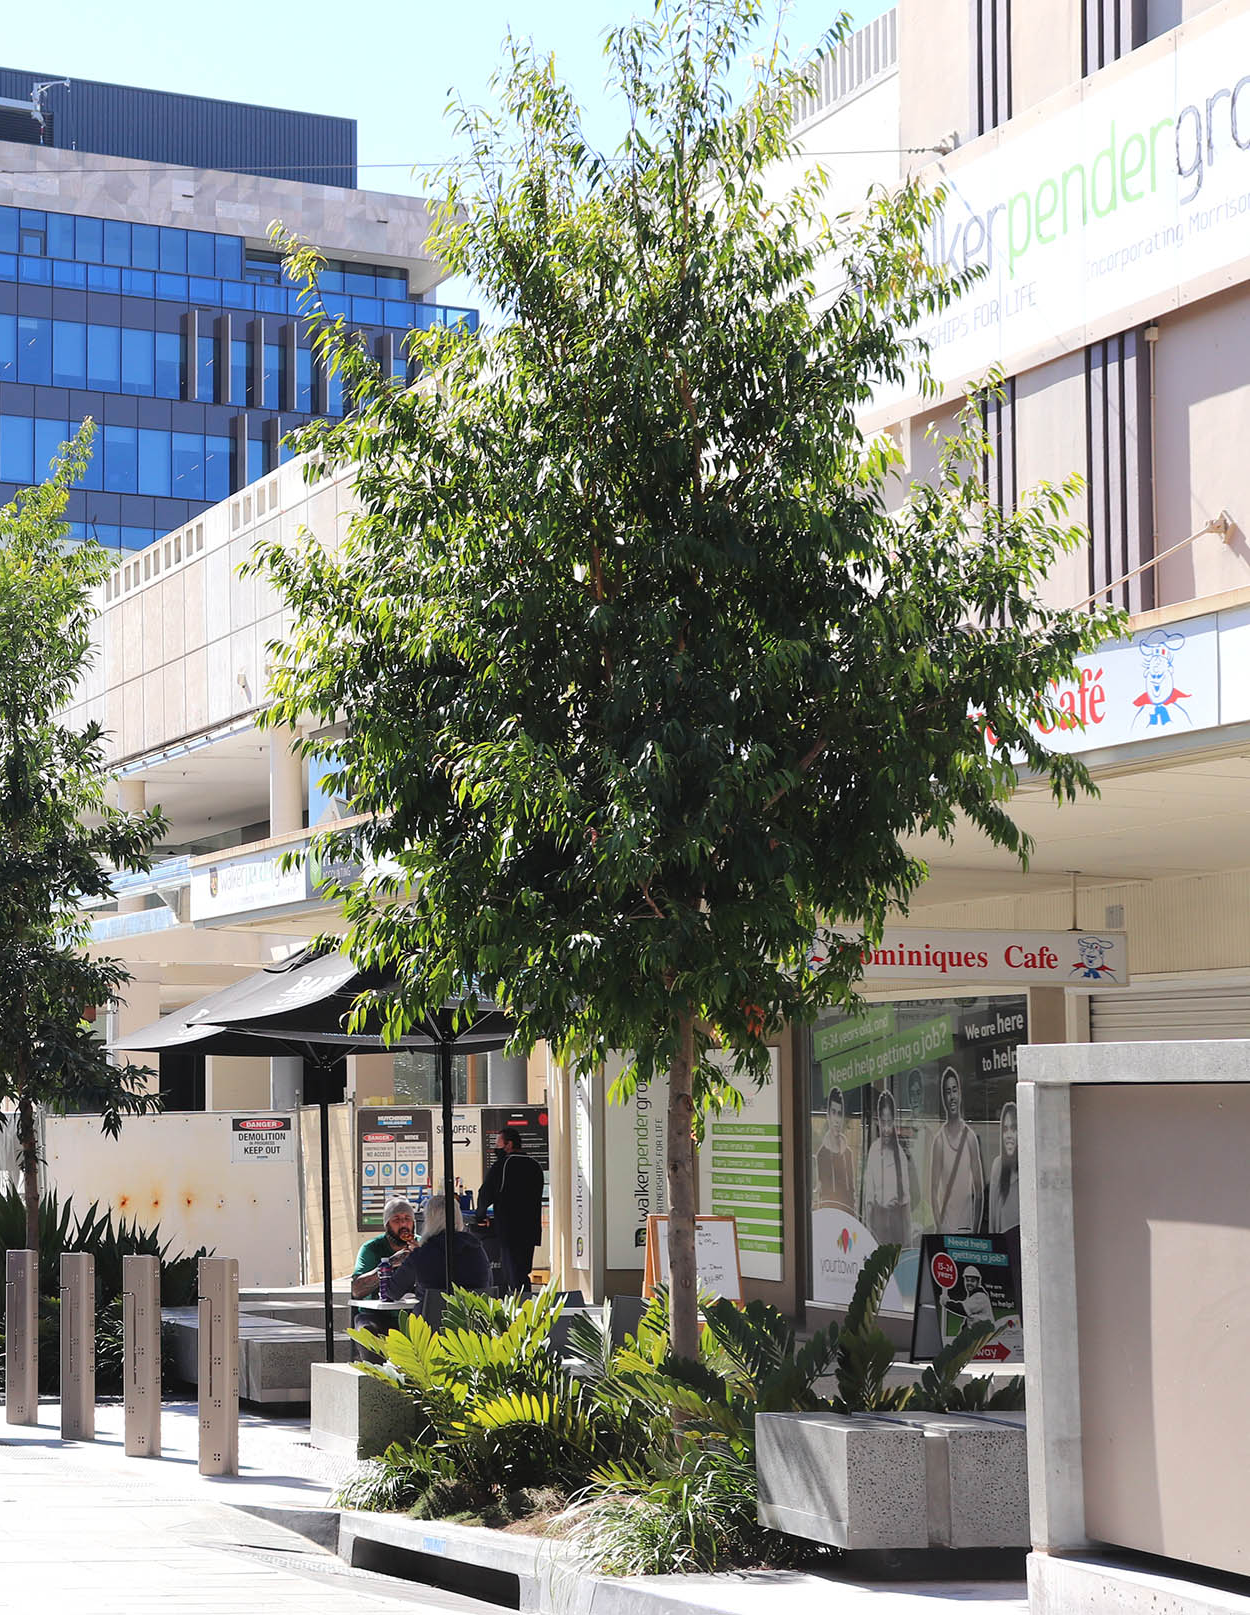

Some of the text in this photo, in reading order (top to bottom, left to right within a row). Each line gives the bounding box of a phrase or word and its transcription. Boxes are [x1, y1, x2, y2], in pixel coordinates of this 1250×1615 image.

[1188, 194, 1250, 236] Morriso
[1005, 280, 1037, 317] LIFE
[858, 943, 1059, 973] ominiques Cafe
[964, 1012, 1024, 1041] We are here
[828, 1022, 947, 1084] Need help getting a job?
[982, 1056, 992, 1072] to
[453, 1124, 478, 1134] OFFICE
[654, 1118, 663, 1137] LIFE
[238, 1132, 286, 1141] DEMOLITION
[243, 1146, 281, 1154] KEEP OUT
[655, 1140, 664, 1157] FOR
[947, 1237, 989, 1250] Need help
[952, 1251, 982, 1263] getting
[988, 1254, 1007, 1264] job?
[937, 1262, 954, 1272] 15-24
[937, 1271, 954, 1280] years
